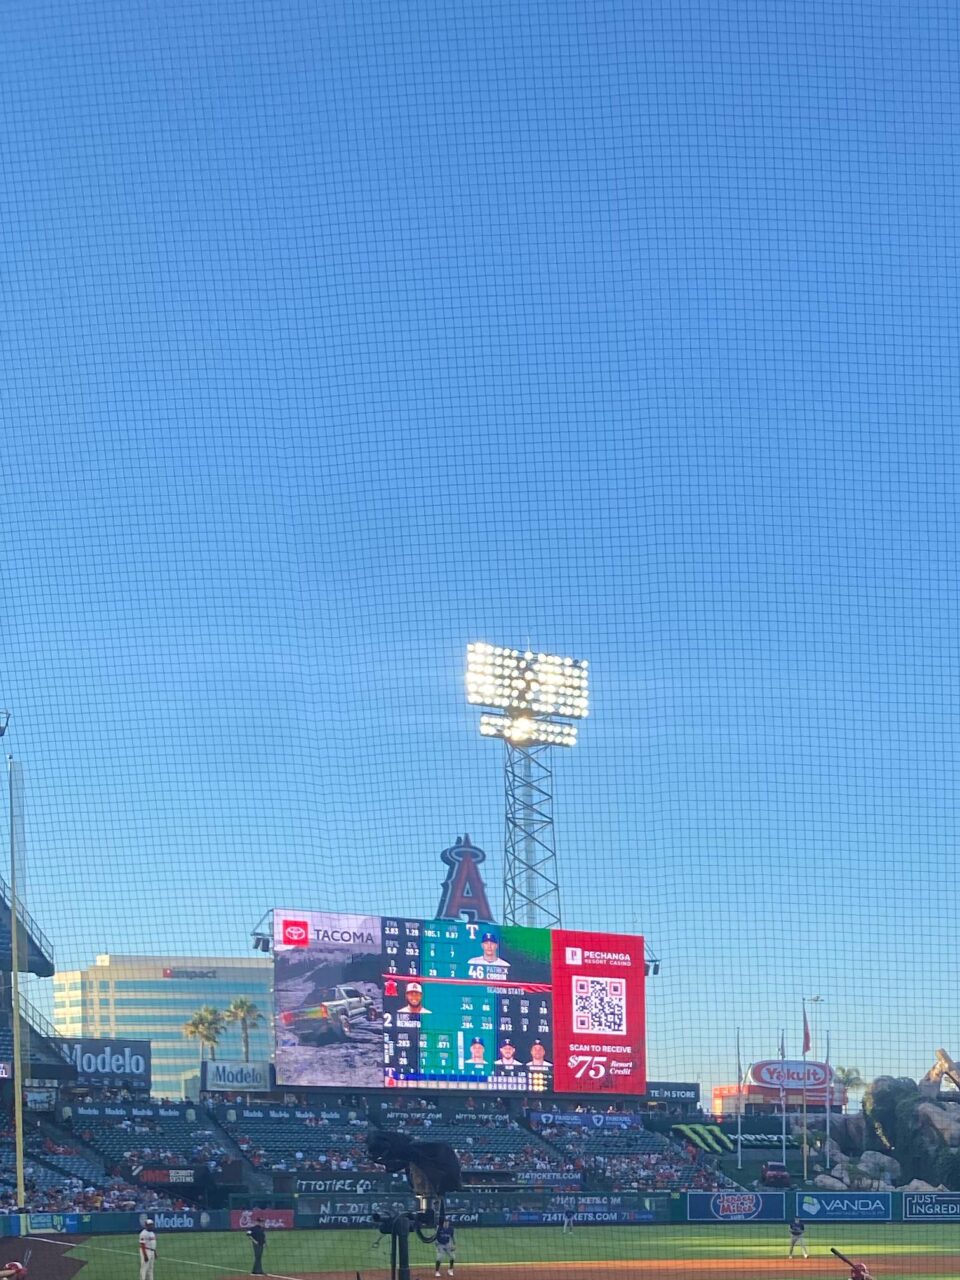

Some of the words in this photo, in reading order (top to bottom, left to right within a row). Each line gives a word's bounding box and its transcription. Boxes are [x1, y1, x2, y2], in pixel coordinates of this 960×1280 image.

[314, 928, 374, 945] TACOMA
[466, 924, 479, 940] T
[584, 951, 631, 961] PECHANGA
[468, 965, 484, 979] 46
[383, 1013, 393, 1027] 2
[569, 1044, 590, 1052] SCAN
[602, 1045, 632, 1053] RECEIVE
[61, 1043, 146, 1074] Modelo
[610, 1060, 633, 1068] Resort
[568, 1055, 607, 1078] $75
[610, 1067, 631, 1075] Credit
[214, 1066, 262, 1084] Modelo
[766, 1067, 821, 1081] Yakult
[672, 1090, 695, 1098] STORE
[821, 1199, 886, 1211] VANDA
[912, 1194, 937, 1204] JUST
[154, 1214, 194, 1228] Modelo
[319, 1216, 348, 1224] NITTO
[542, 1212, 618, 1221] 714TIKETS.COM
